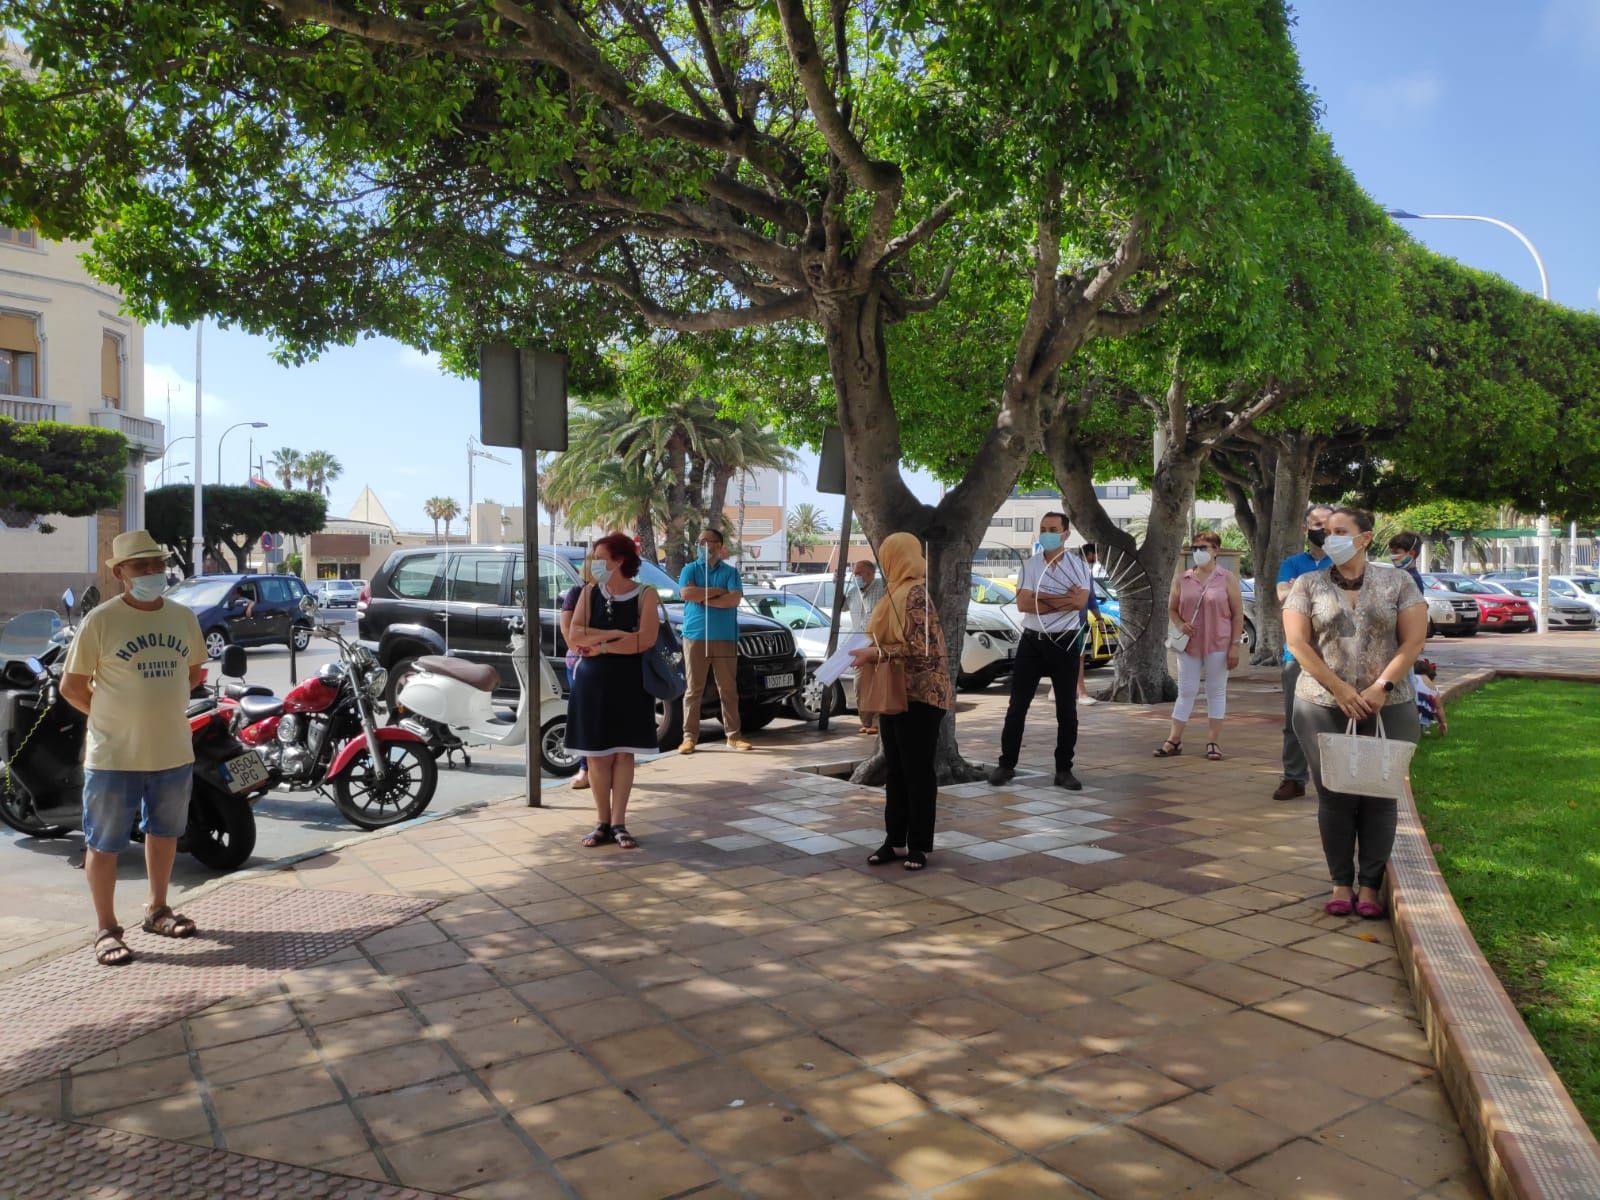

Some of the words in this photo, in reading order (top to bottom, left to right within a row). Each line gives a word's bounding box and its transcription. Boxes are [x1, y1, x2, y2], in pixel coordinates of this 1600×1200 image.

[116, 633, 190, 661] HONOLULU
[137, 662, 146, 670] US
[149, 661, 168, 669] STATE
[170, 660, 177, 668] OF
[144, 670, 174, 678] HAWAII
[229, 754, 258, 774] 8504
[240, 768, 259, 786] JPG
